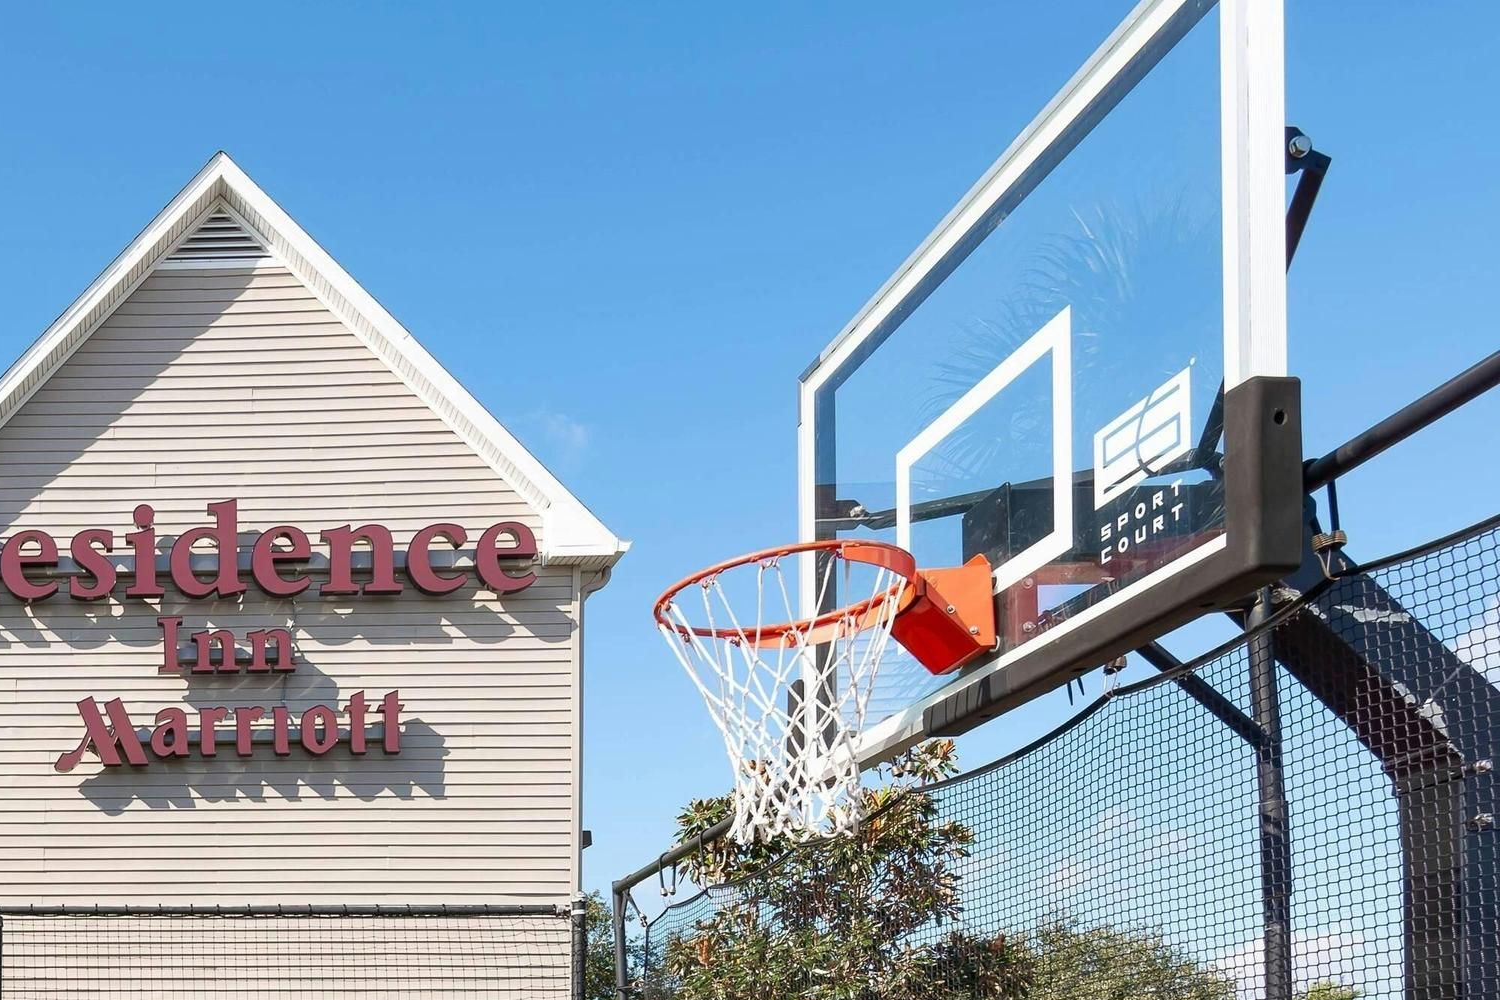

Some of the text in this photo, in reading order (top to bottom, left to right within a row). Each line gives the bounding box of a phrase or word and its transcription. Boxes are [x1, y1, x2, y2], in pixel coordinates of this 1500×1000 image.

[1101, 478, 1183, 542] SPORT
[1101, 503, 1183, 565] COURT
[157, 615, 297, 675] Inn
[54, 689, 405, 773] Marriott
